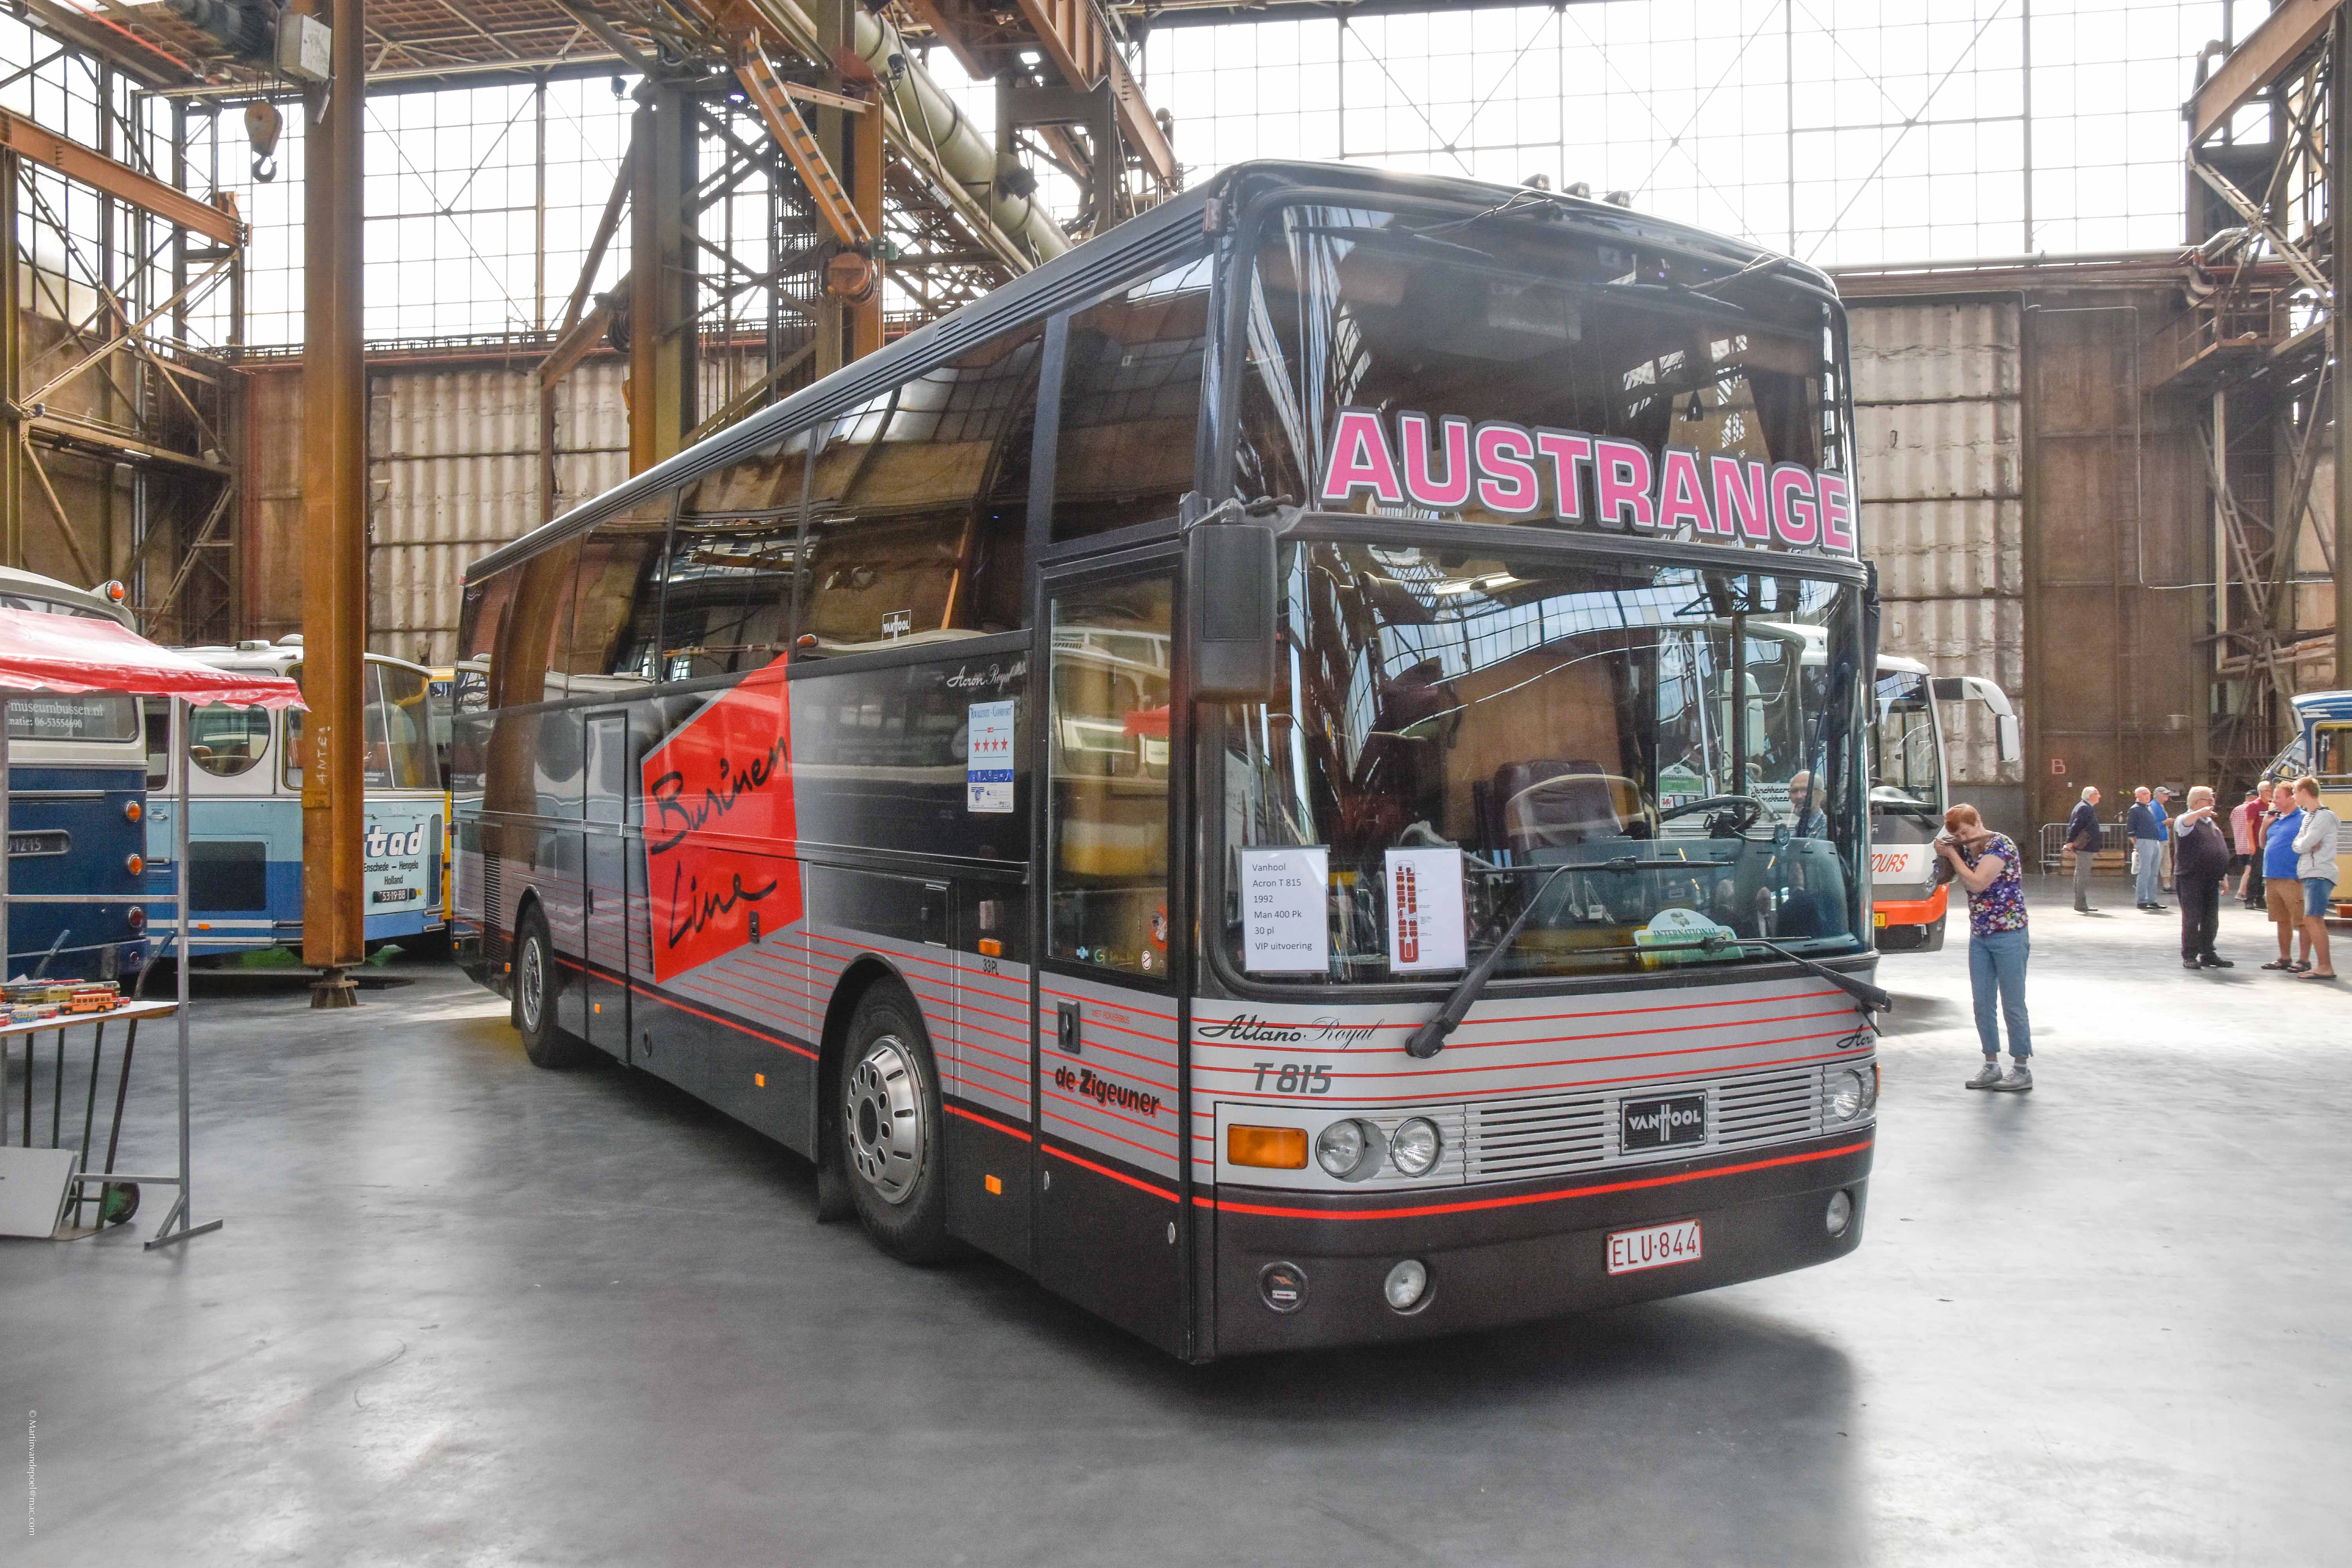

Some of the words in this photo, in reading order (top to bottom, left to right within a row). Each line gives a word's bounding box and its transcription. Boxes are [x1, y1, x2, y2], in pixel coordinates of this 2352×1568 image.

[1319, 410, 1855, 554] AUSTRANGE
[946, 665, 985, 688] Acron
[986, 664, 1015, 693] Royal
[2051, 759, 2066, 774] B
[364, 862, 389, 873] Enschede
[399, 860, 419, 872] Hengelo
[1252, 863, 1286, 871] Vanhool
[384, 875, 403, 886] Holland
[1286, 878, 1301, 887] 815
[669, 860, 777, 949] Line
[1292, 910, 1302, 918] Pk
[1267, 926, 1274, 936] pl
[1271, 942, 1312, 951] uitvoering
[1198, 1014, 1302, 1042] Altano
[1303, 1016, 1385, 1051] Royal
[1055, 1065, 1075, 1093] de
[1079, 1068, 1161, 1118] Zigeuner
